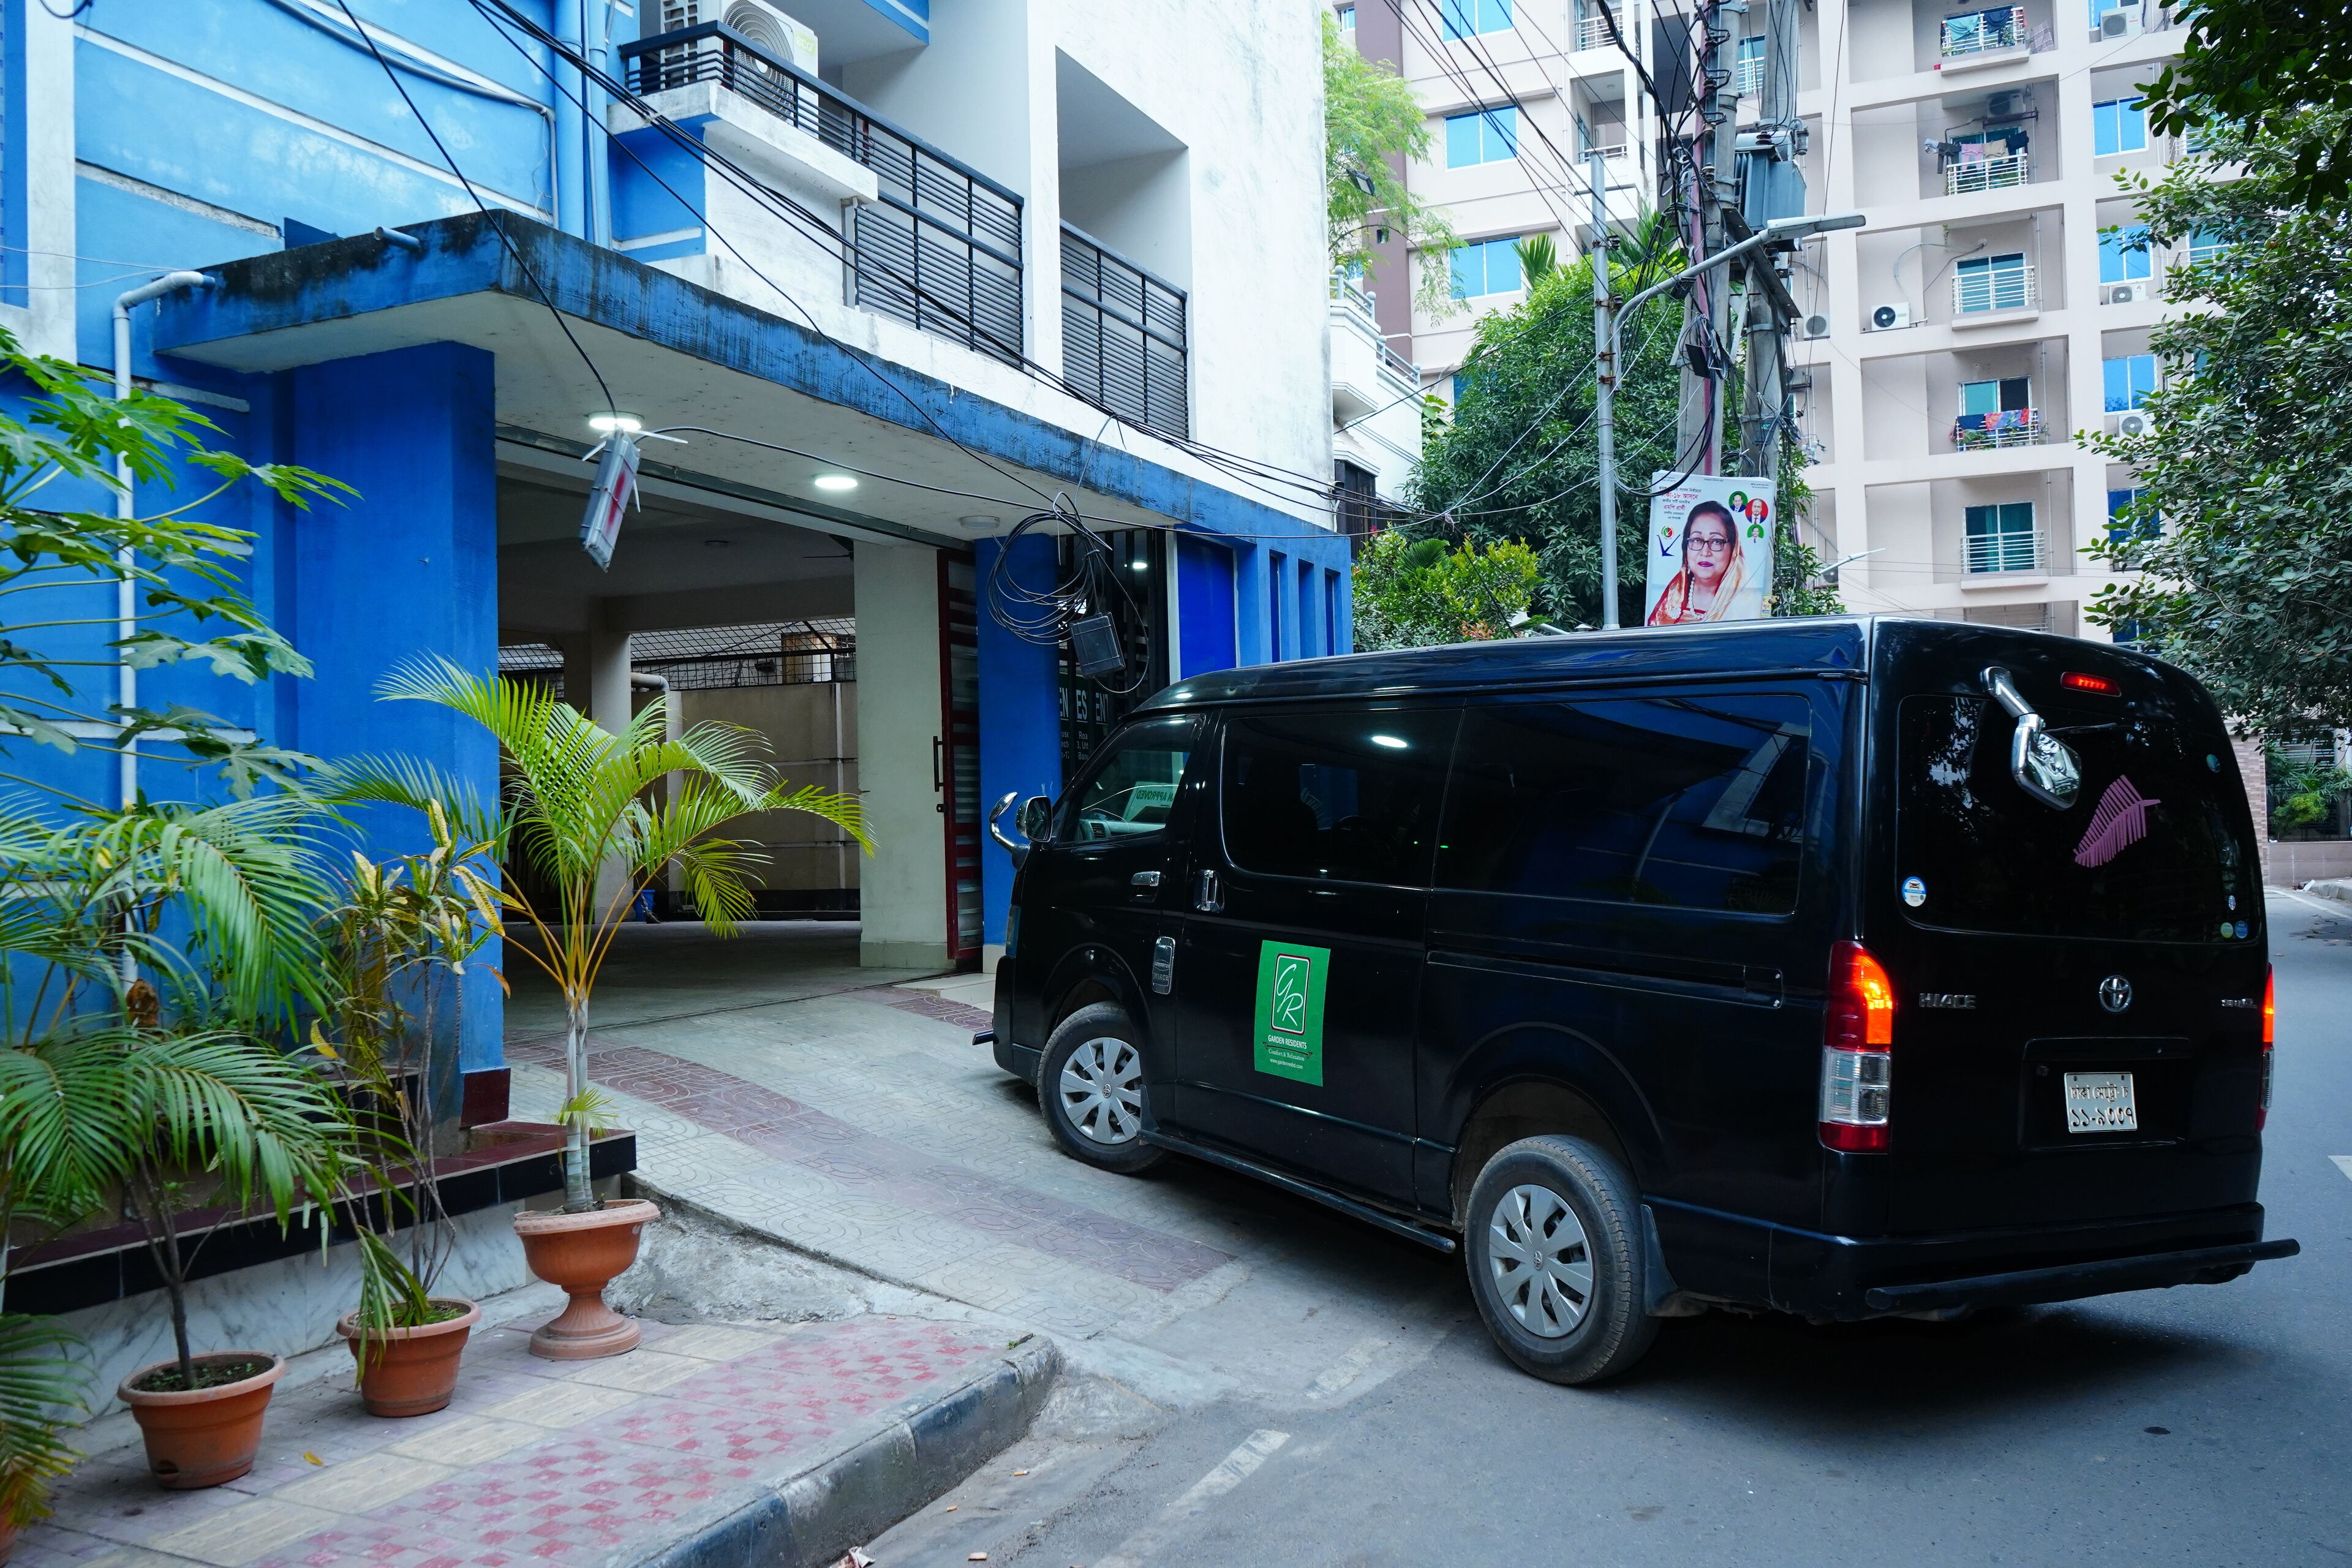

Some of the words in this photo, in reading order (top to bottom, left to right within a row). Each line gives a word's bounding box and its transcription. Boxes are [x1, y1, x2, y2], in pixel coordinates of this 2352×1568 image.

[1919, 993, 1977, 1009] HIACE
[1268, 1035, 1284, 1045] GARDEN
[1285, 1038, 1307, 1049] RESIDENTS
[1268, 1048, 1283, 1057] Comfort
[1287, 1052, 1305, 1061] Relaxation
[2070, 1084, 2090, 1100] ঢাকা
[2070, 1107, 2135, 1127] ১১-৯৩৩৭
